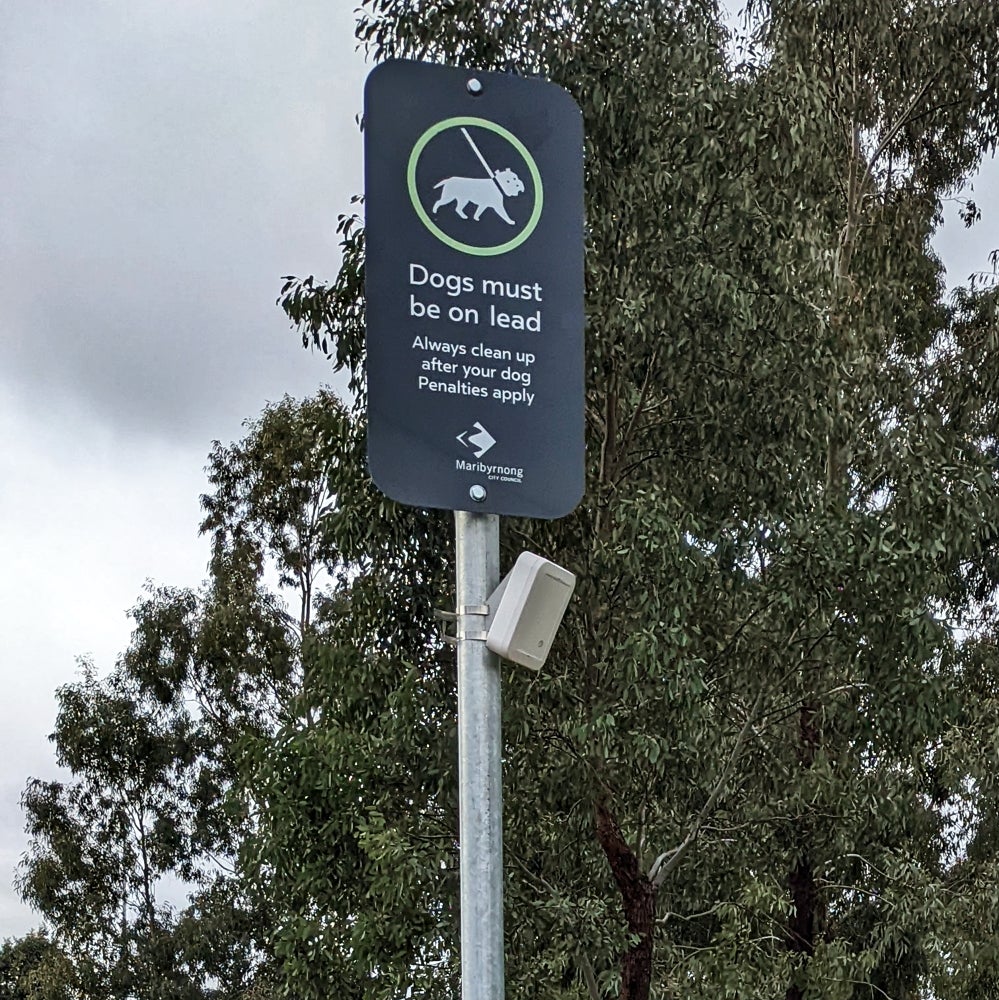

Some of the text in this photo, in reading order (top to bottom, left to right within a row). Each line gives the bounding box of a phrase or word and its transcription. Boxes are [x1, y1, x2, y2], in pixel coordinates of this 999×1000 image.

[409, 263, 543, 302] Dogs must
[410, 294, 541, 332] be on lead
[412, 335, 536, 364] Always clean up
[421, 357, 531, 387] after your dog
[418, 376, 535, 407] Penalties apply
[456, 459, 524, 478] Maribyrnong
